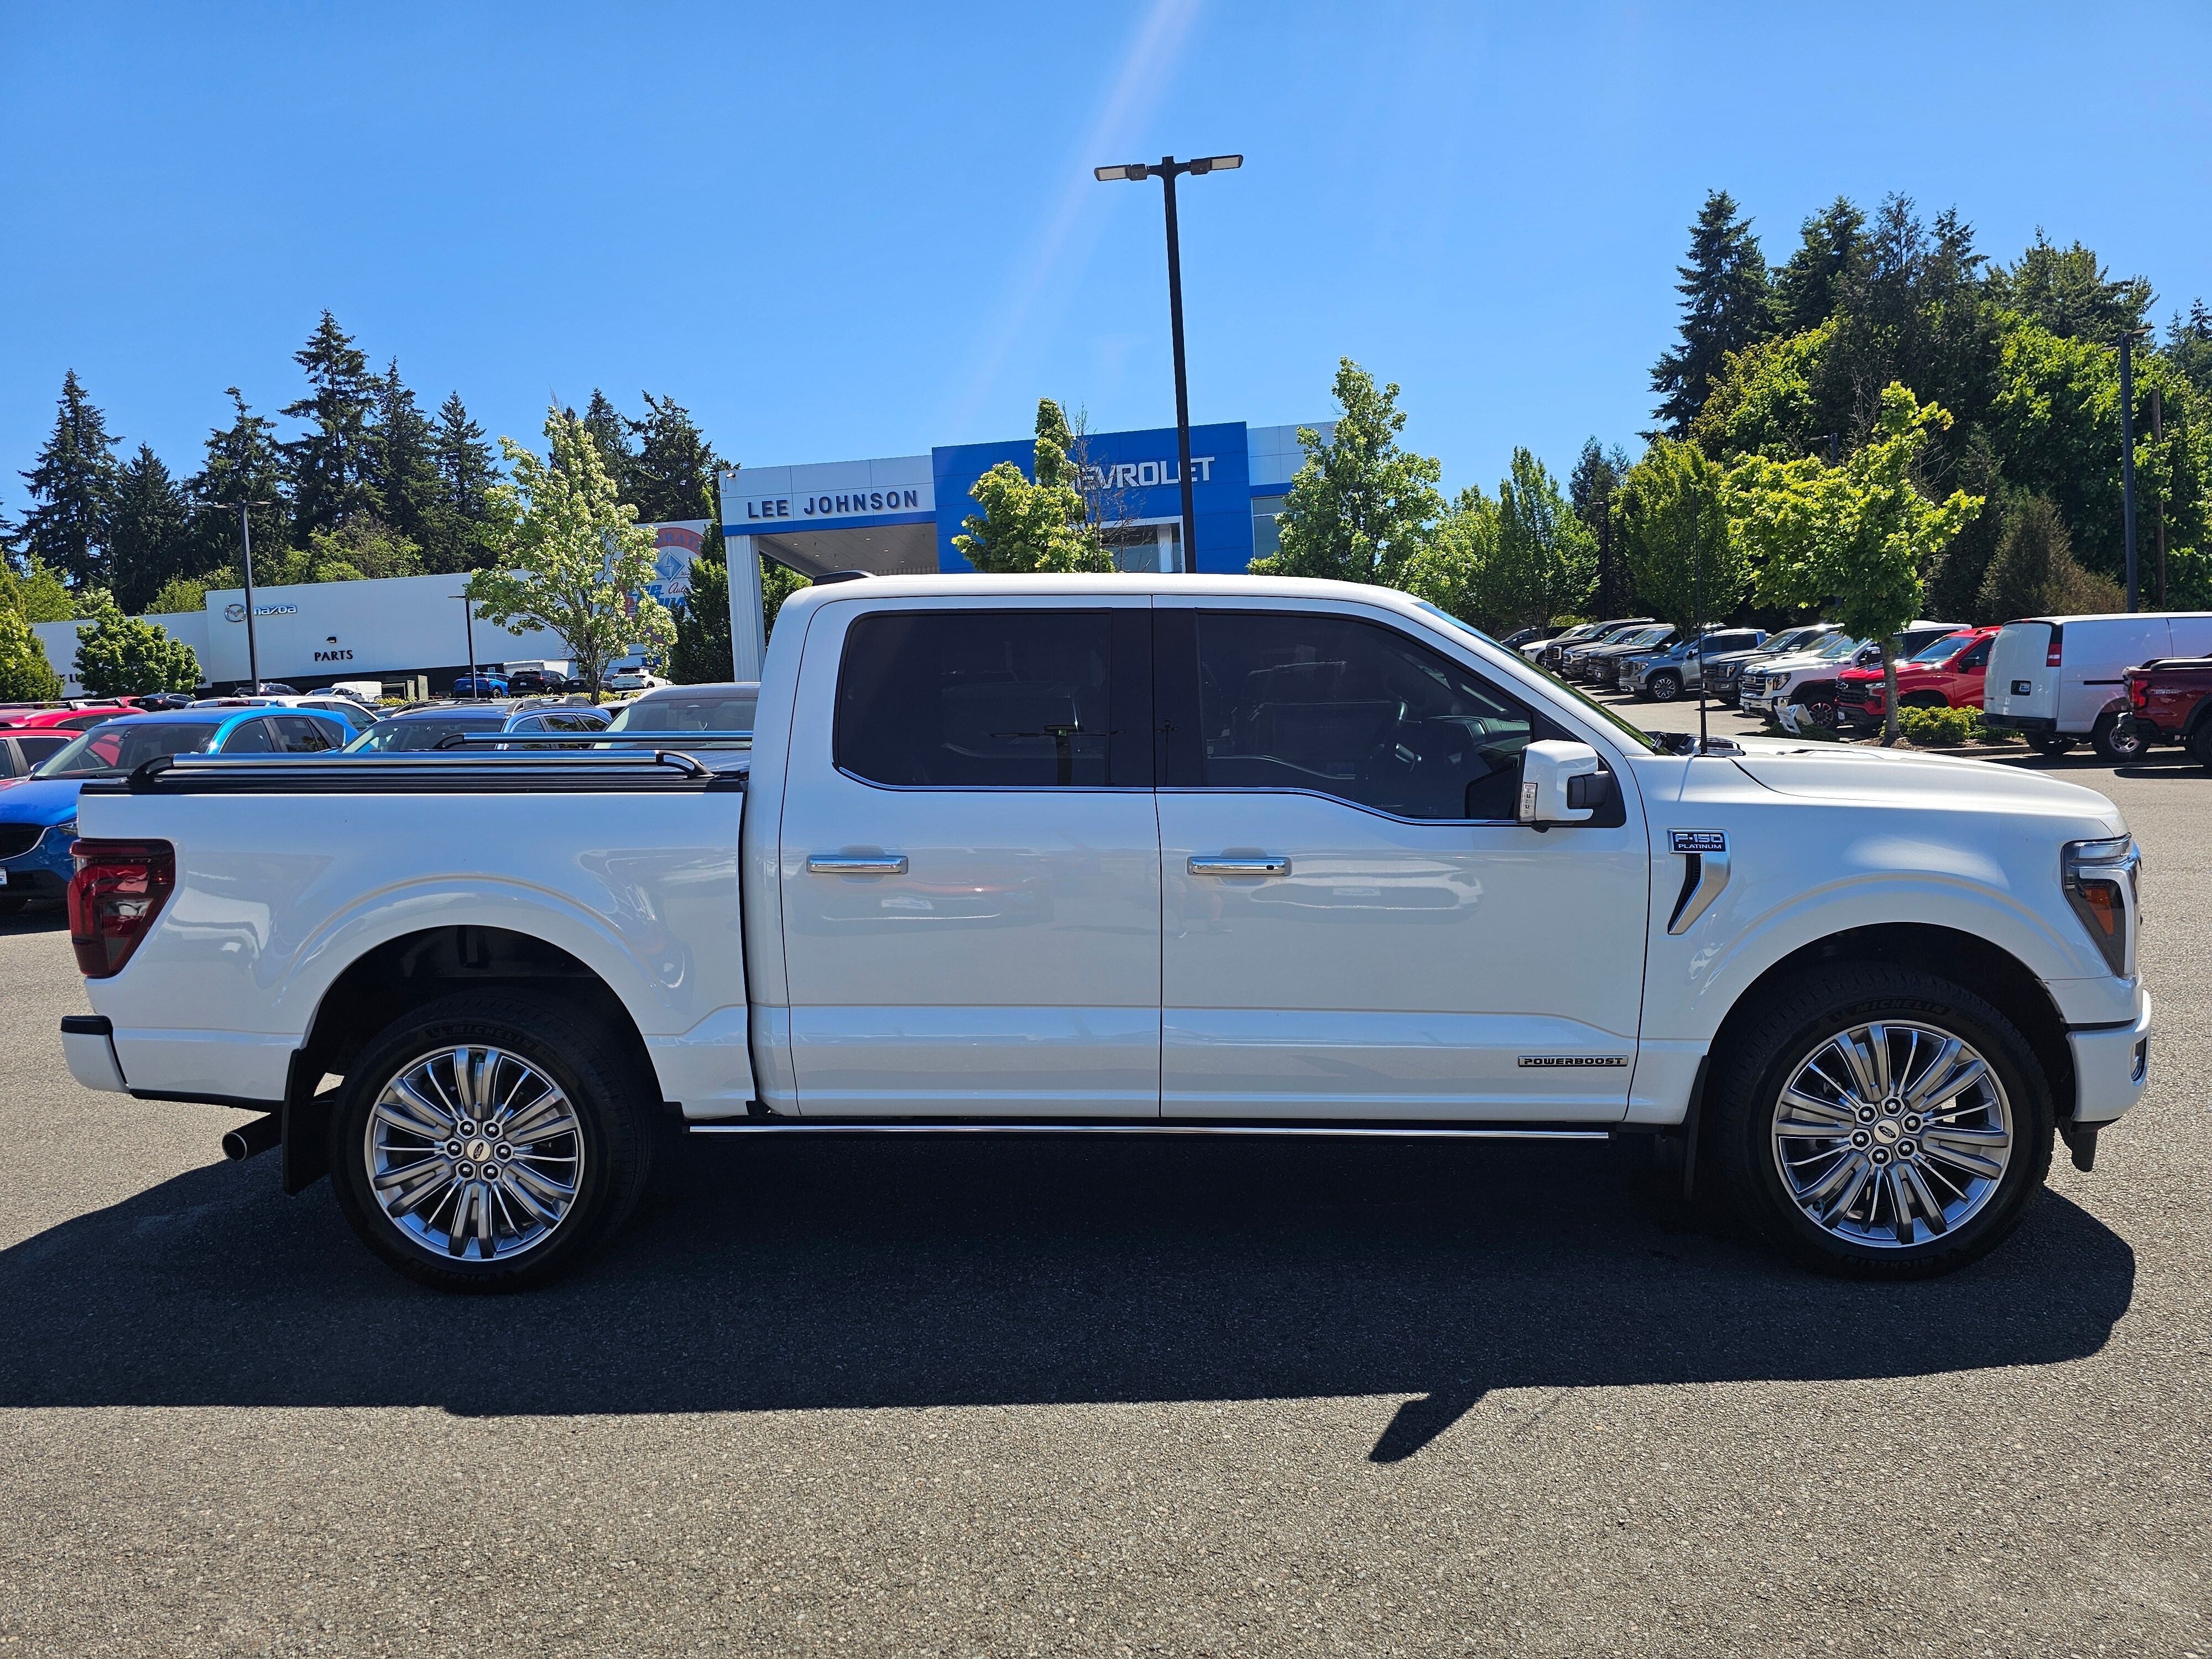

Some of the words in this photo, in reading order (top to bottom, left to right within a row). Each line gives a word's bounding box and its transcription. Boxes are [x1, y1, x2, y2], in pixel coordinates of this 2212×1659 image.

[1035, 456, 1215, 491] EVROLT
[748, 499, 789, 518] LEE
[804, 490, 917, 515] JOHNSON
[314, 650, 353, 662] PARTS
[1674, 833, 1724, 843] F-150
[1855, 999, 1947, 1015] MICHELIN
[453, 1026, 535, 1050] MICHELIN
[1880, 1126, 1895, 1137] Ford
[473, 1144, 483, 1158] Ford
